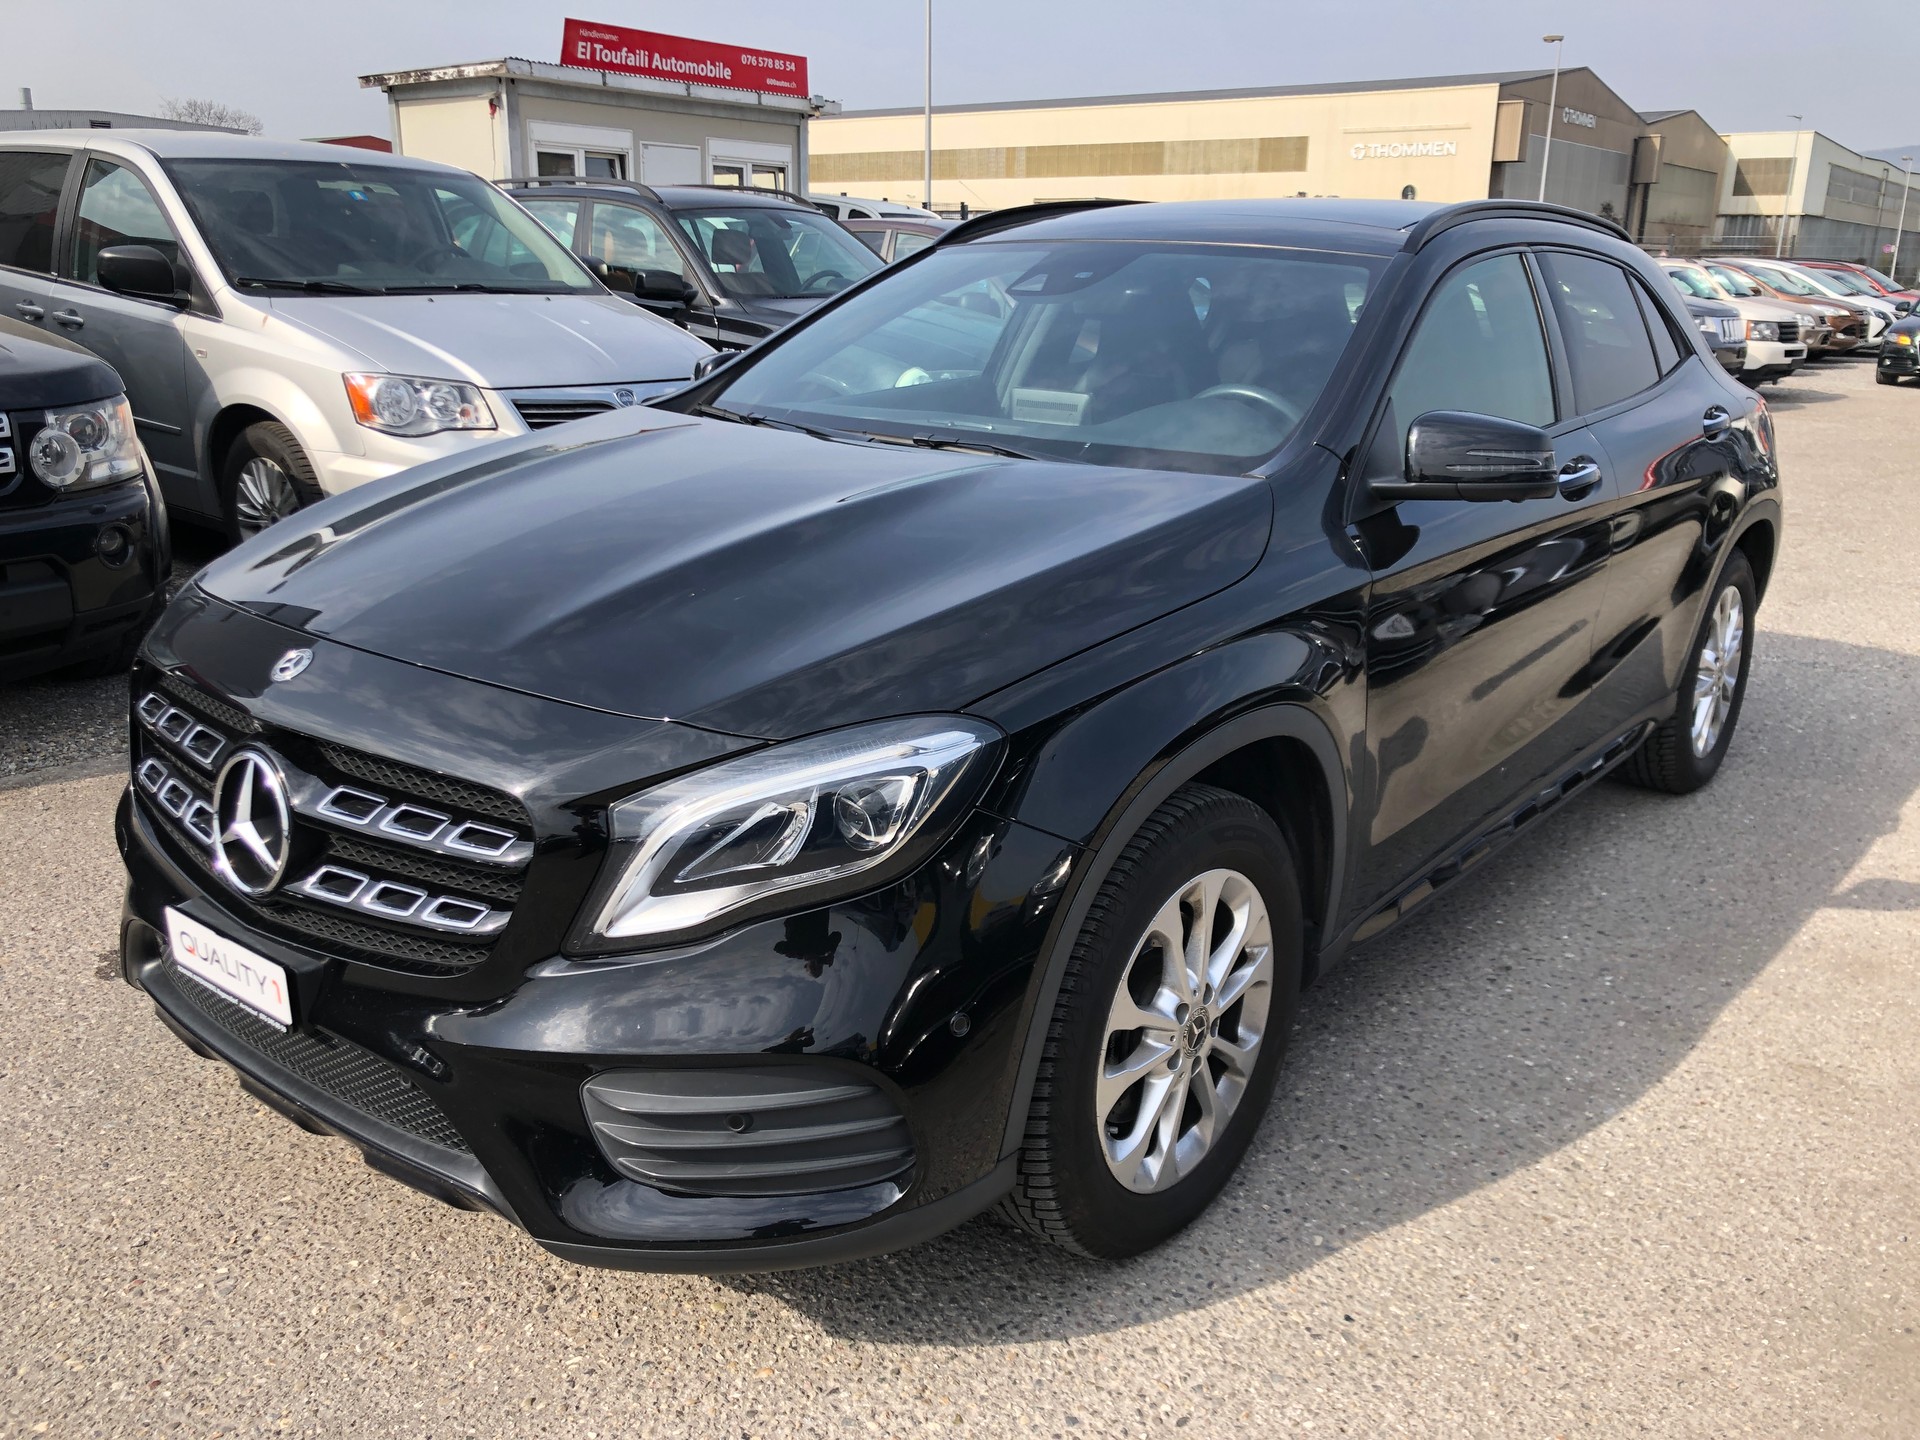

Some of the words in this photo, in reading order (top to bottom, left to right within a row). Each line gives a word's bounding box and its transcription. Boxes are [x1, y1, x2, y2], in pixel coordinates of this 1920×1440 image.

[580, 29, 619, 41] Händlername:
[577, 41, 591, 60] El
[594, 43, 649, 68] Toufaili
[652, 53, 731, 79] Automobile
[741, 54, 757, 66] 076
[758, 58, 773, 68] 578
[774, 59, 784, 70] 85
[785, 61, 796, 72] 54
